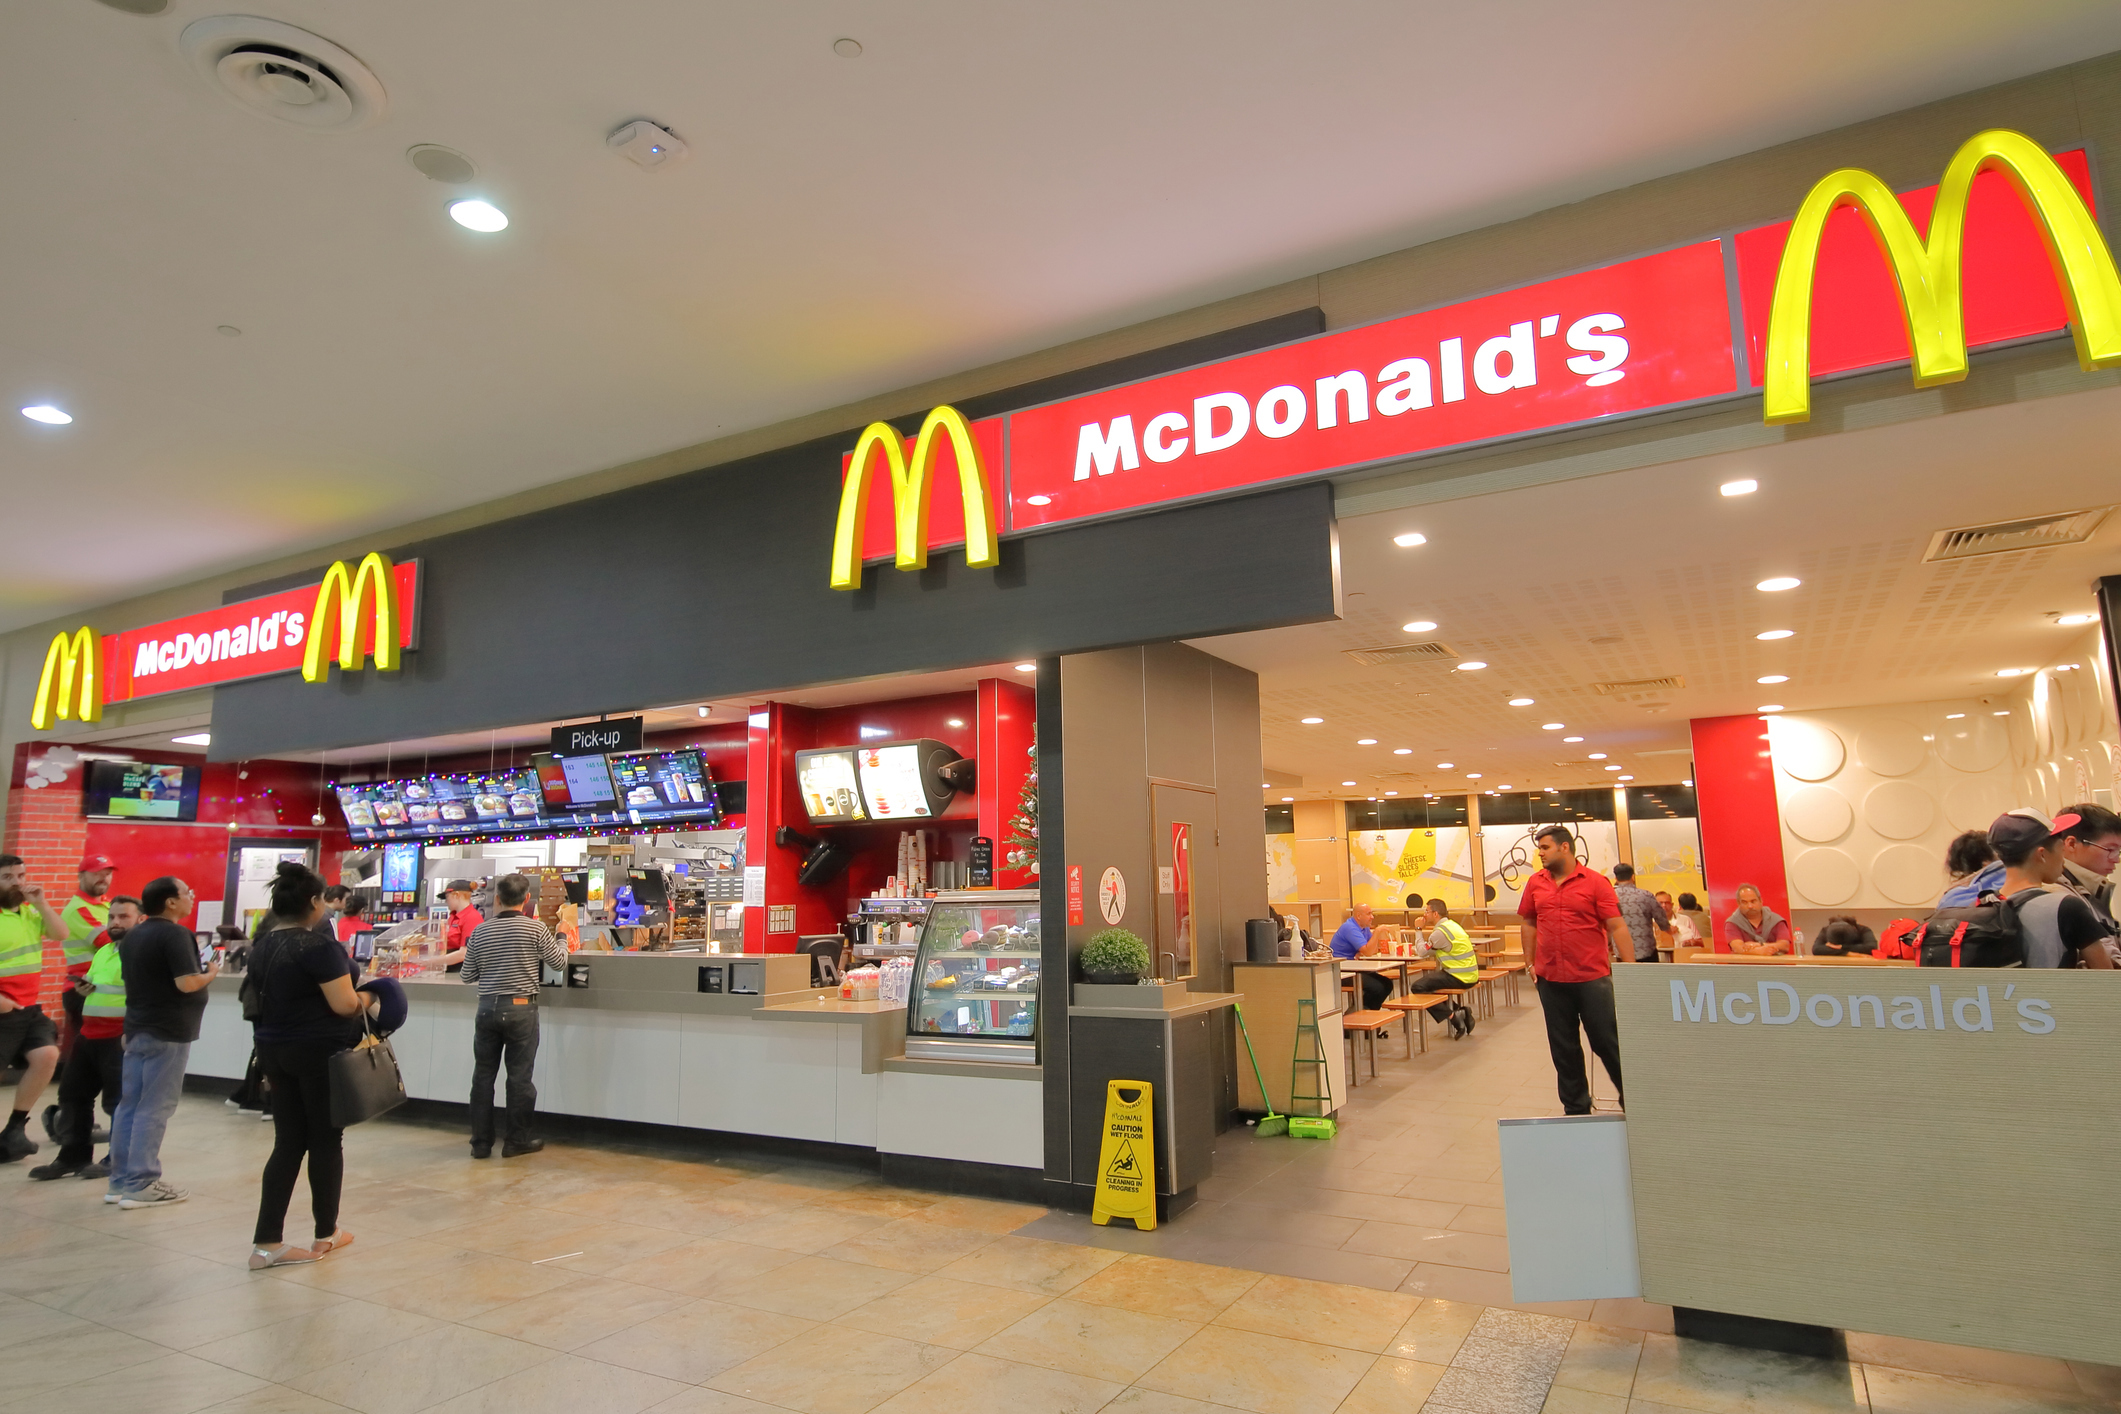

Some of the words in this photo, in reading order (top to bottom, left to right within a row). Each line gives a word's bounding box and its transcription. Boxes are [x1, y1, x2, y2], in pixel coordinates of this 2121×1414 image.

[1072, 311, 1631, 482] McDonald's
[133, 610, 305, 678] McDonald's
[571, 729, 621, 749] Pick-up
[1403, 855, 1427, 864] CHEESE
[1398, 863, 1419, 872] SLICES
[1162, 871, 1170, 879] Staff
[1162, 881, 1170, 889] Only
[1669, 980, 2057, 1035] McDonald's
[1111, 1124, 1143, 1133] CAUTION
[1105, 1177, 1135, 1187] CLEANING
[1108, 1184, 1140, 1194] PROGRESS
